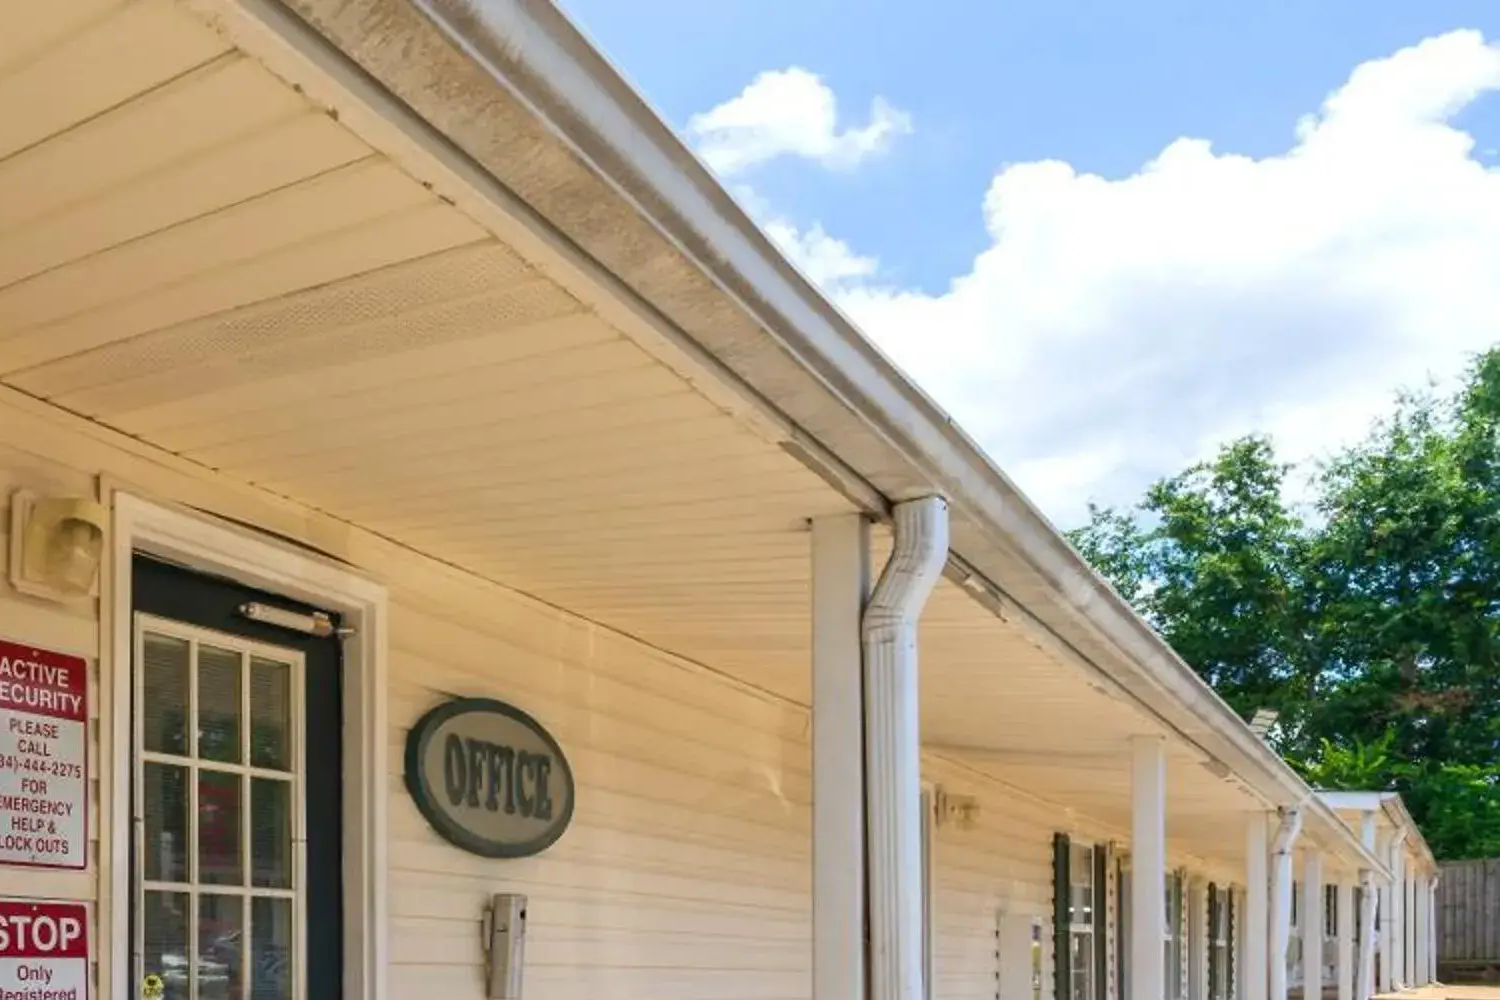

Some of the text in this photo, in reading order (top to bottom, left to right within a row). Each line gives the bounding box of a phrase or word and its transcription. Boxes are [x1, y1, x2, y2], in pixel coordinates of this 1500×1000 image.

[9, 718, 59, 739] PLEASE
[17, 739, 51, 757] CALL
[444, 733, 552, 819] OFFICE
[21, 777, 47, 794] FOR
[11, 817, 56, 834] HELP &
[35, 837, 69, 855] OUTS
[17, 965, 53, 985] Only
